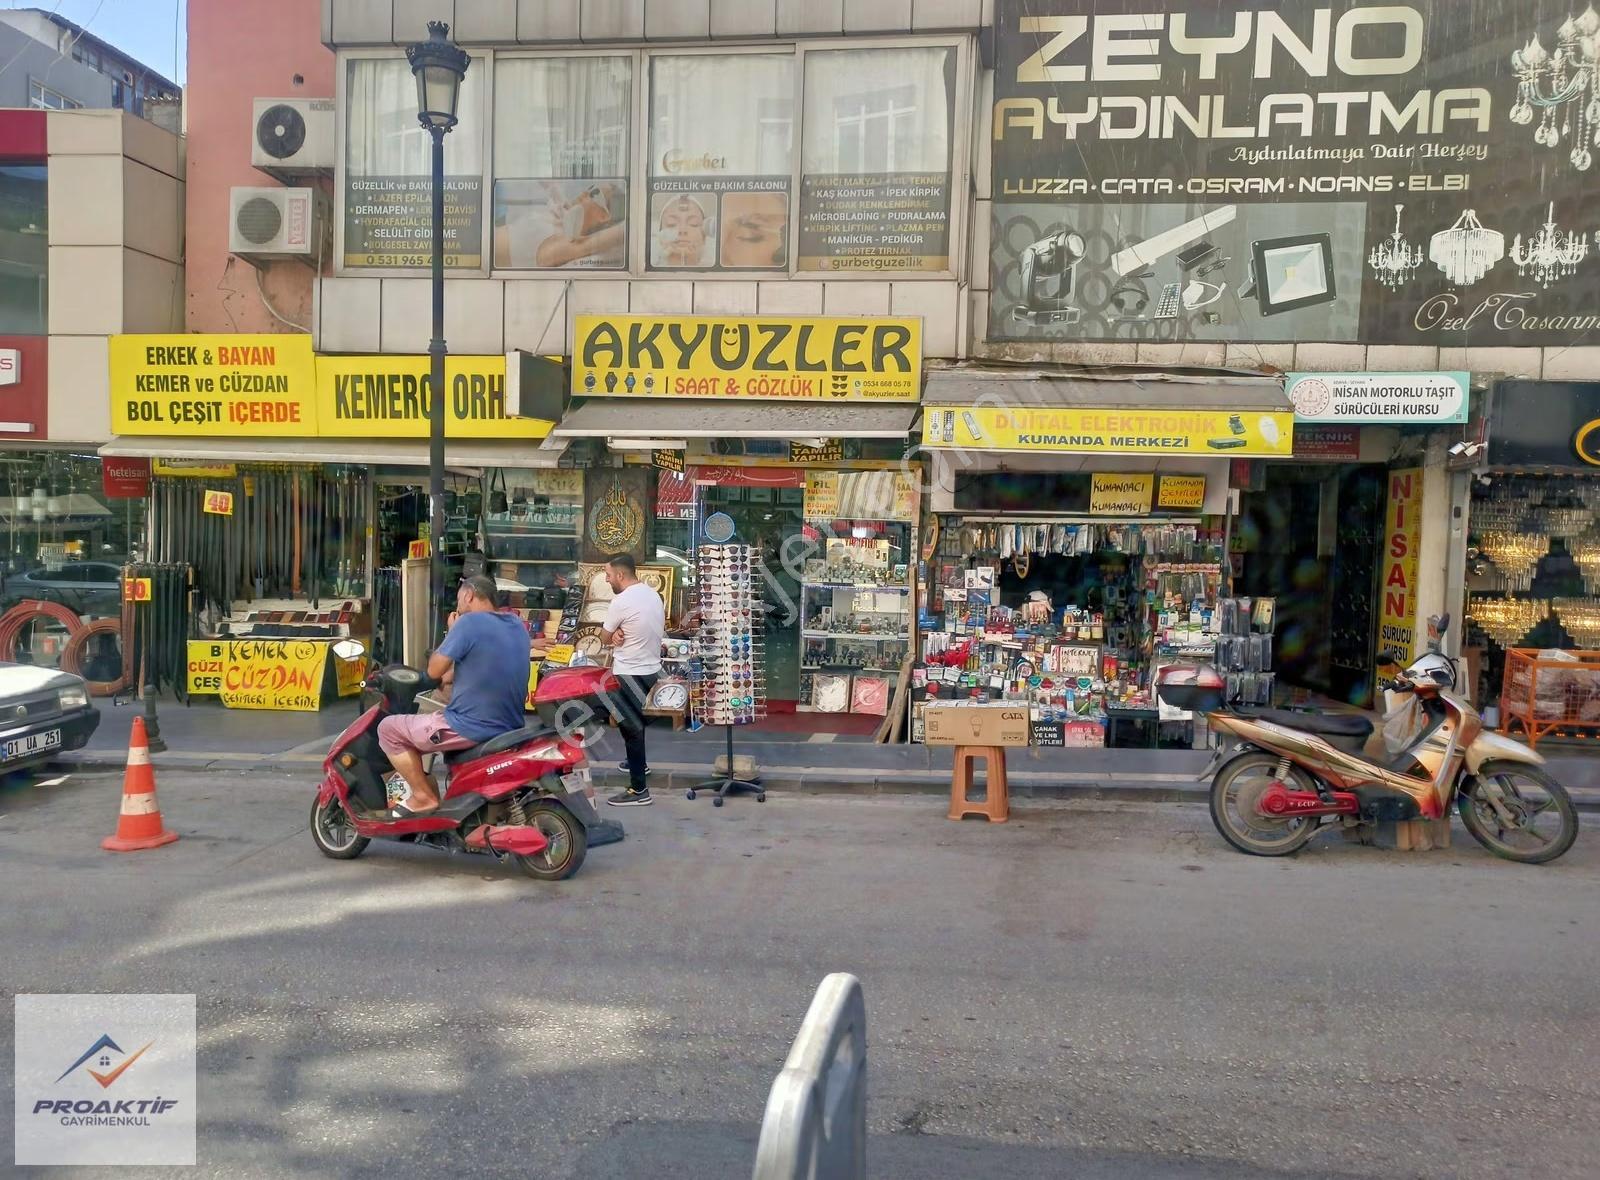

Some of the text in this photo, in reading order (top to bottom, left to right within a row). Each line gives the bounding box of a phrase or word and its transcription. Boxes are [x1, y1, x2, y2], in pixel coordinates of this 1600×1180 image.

[1016, 6, 1424, 83] ZEYNO
[994, 87, 1492, 140] AYDINLATMA
[1371, 142, 1415, 160] Dair
[352, 180, 395, 190] GÜZELLİK
[396, 182, 407, 190] ve
[408, 181, 432, 190] BAKI
[653, 181, 698, 190] GÜZELLİK
[714, 181, 745, 190] BAKIM
[747, 181, 787, 190] SALONU
[816, 186, 940, 198] KAŞ KONTUR İPEK KİRPİK
[1003, 175, 1470, 195] LUZZA CATA OSRAM NOANS ELBI
[355, 206, 408, 214] DERMAPEN
[443, 205, 476, 214] EDAVİSİ
[809, 211, 946, 221] MİCROBLADİNG PUDRALAMA
[374, 228, 411, 238] SELÜLİT
[827, 234, 924, 244] MANİKÜR PEDİKÜR
[378, 256, 398, 264] 531
[401, 256, 423, 264] 965
[1414, 287, 1472, 331] Özel
[146, 347, 275, 365] ERKEK & BAYAN
[582, 321, 912, 373] AKYÜZLER
[136, 371, 289, 393] KEMER ve CÜZDAN
[674, 375, 813, 397] SAAT & GÖZLÜK
[1335, 385, 1368, 398] NİSAN
[1370, 387, 1423, 398] MOTORLU
[1425, 387, 1456, 401] TAŞIT
[127, 401, 301, 425] BOL ÇEŞİT İÇERDE
[1334, 403, 1440, 415] SÜRÜCÜLERİ KURSU
[994, 412, 1217, 434] DİJİTAL ELEKTRONİK
[1018, 434, 1190, 448] KUMANDA MERKEZİ
[1382, 624, 1412, 644] SÜRÜCÜ
[228, 641, 289, 663] KEMER
[193, 676, 222, 690] ÇEŞ
[225, 659, 322, 692] CÜZDAN
[7, 731, 60, 754] 01 UA 251
